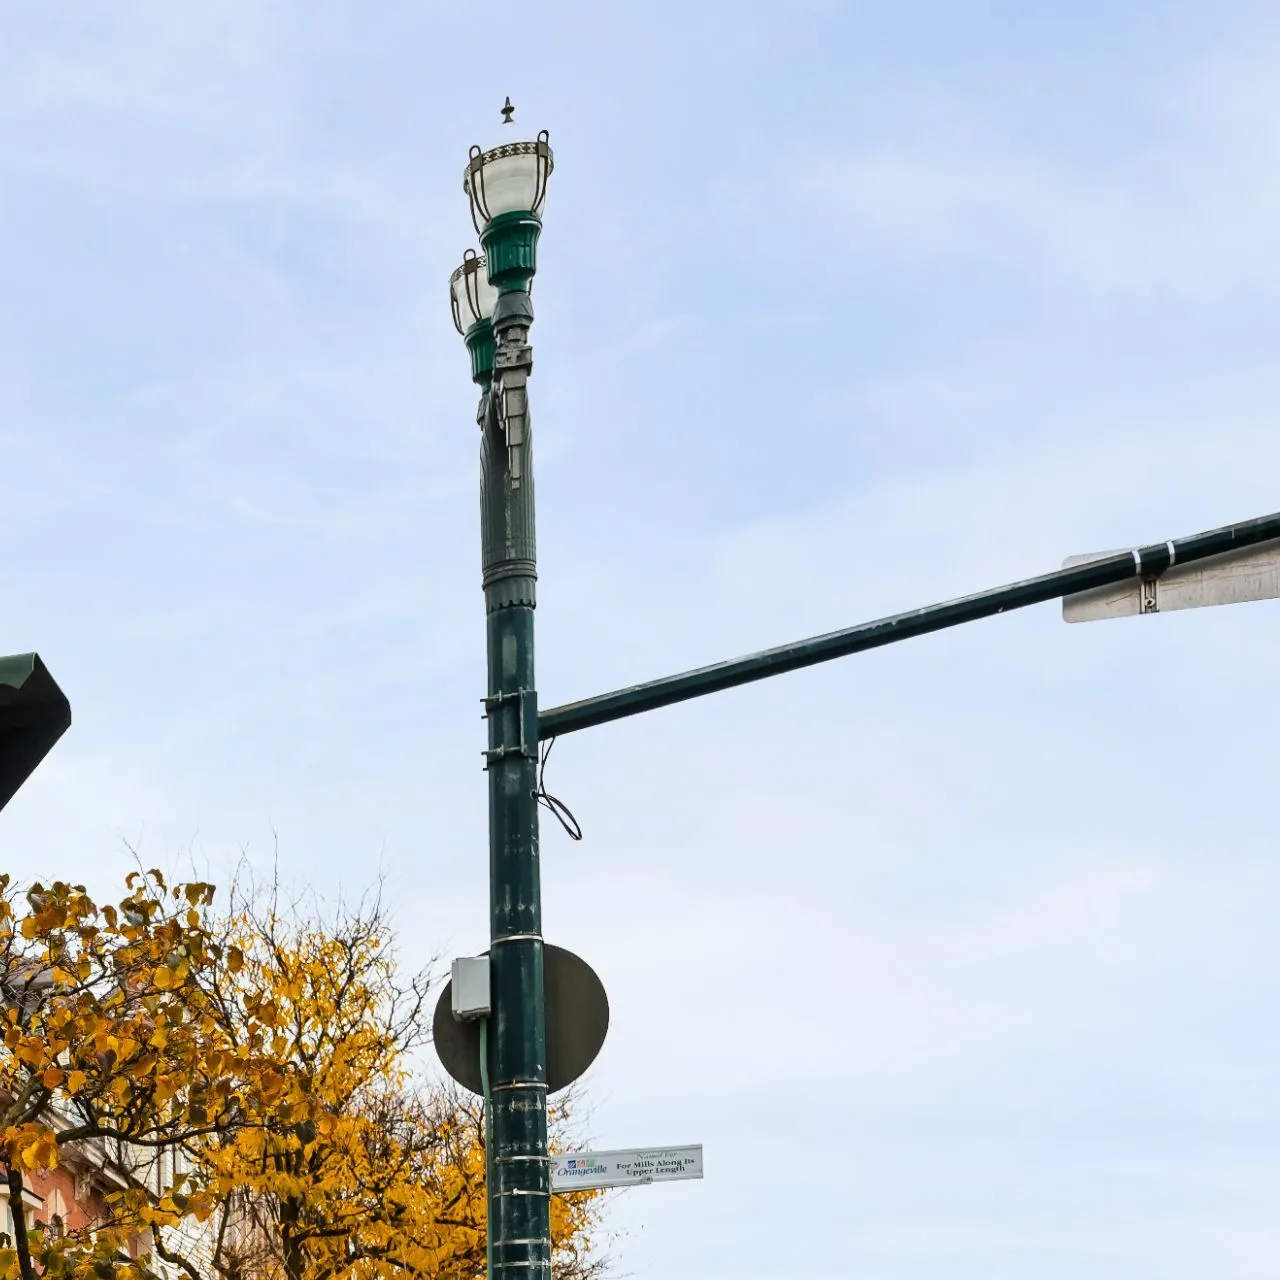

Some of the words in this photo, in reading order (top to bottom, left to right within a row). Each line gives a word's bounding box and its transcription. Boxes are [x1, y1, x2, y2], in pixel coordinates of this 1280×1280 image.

[557, 1164, 607, 1176] Orangeville
[634, 1161, 654, 1169] Mills
[656, 1159, 682, 1168] Along
[626, 1168, 653, 1177] Upper
[656, 1165, 685, 1174] Length
